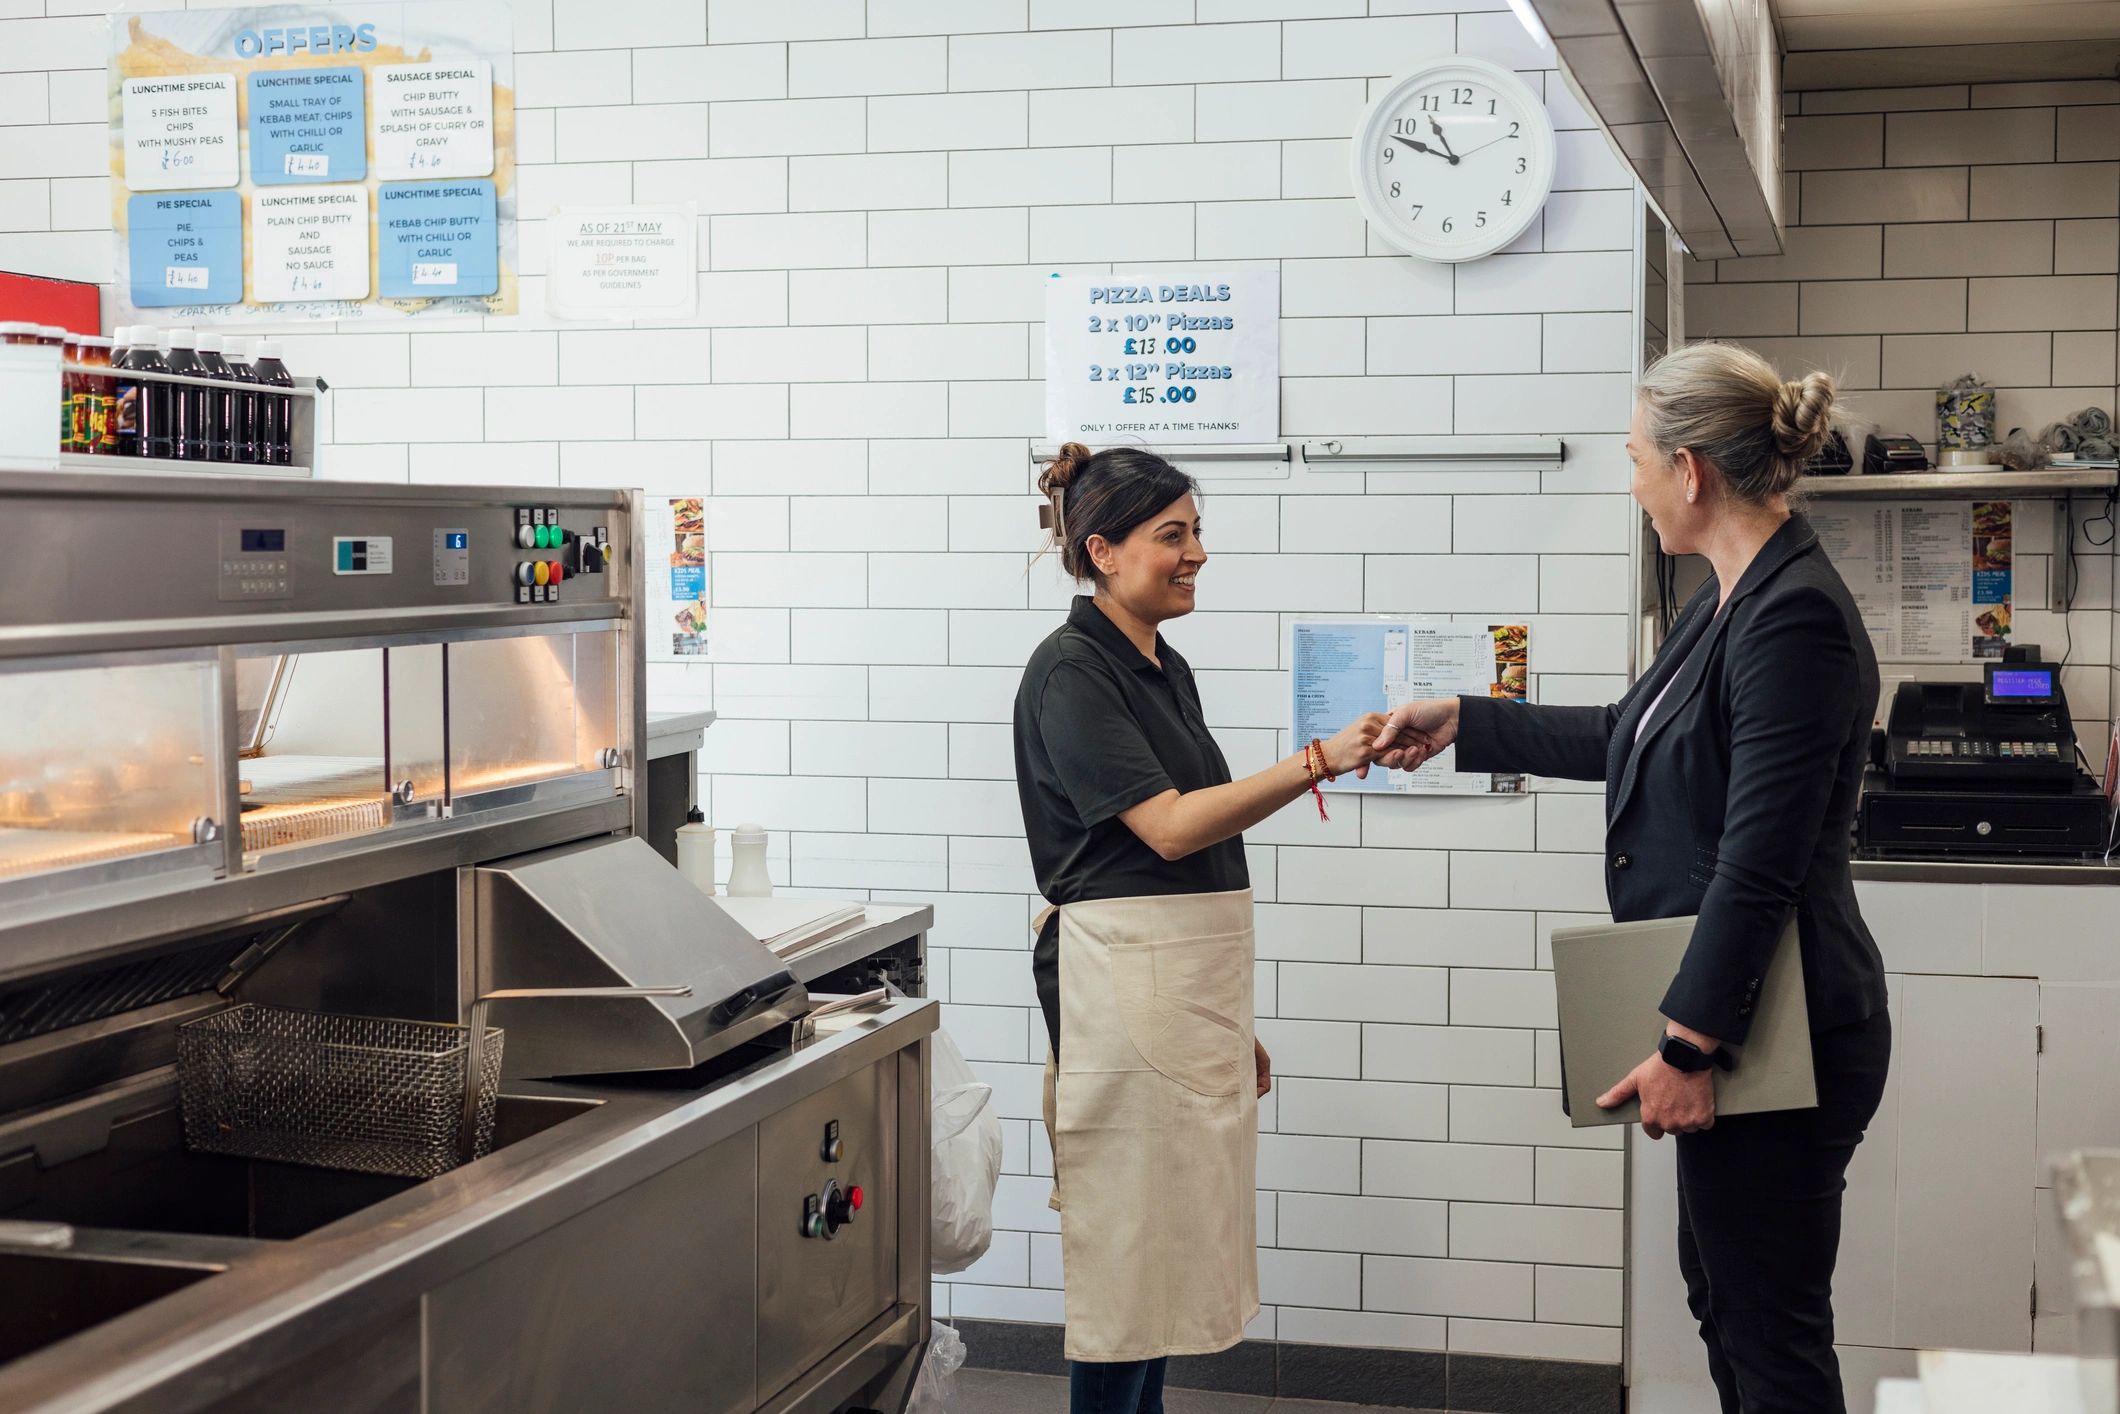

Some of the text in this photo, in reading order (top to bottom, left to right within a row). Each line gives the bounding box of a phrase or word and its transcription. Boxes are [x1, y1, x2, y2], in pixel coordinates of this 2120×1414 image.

[234, 23, 378, 60] OFFERS
[256, 75, 353, 88] LUNCHTIME SPECIAL
[386, 71, 475, 83] SAUSAGE SPECIAL
[131, 81, 226, 94] LUNCHTIME SPECIAL
[403, 91, 459, 102] CHIP BUTTY
[1450, 87, 1474, 105] 12
[269, 97, 342, 109] SMALL TRAY OF
[1419, 94, 1441, 112] 11
[1487, 98, 1497, 116] 1
[151, 107, 208, 118] 5 FISH BITES
[259, 114, 292, 124] KEBAB
[325, 111, 353, 121] CHIPS
[391, 106, 473, 118] WITH SAUSAGE &
[166, 122, 194, 132] CHIPS
[379, 120, 485, 134] SPLASH OF CURRY OR
[1393, 117, 1418, 136] 10
[1508, 121, 1520, 139] 2
[270, 127, 343, 139] WITH CHILLI OR
[137, 136, 224, 148] WITH MUSHY PEAS
[289, 143, 324, 153] GARLIC
[416, 137, 448, 147] GRAVY
[1383, 147, 1395, 165] 9
[1514, 156, 1527, 175] 3
[384, 187, 483, 201] LUNCHTIME SPECIAL
[1389, 181, 1402, 199] 8
[261, 195, 358, 207] LUNCHTIME SPECIAL
[1500, 189, 1512, 206] 4
[157, 199, 212, 210] PIE SPECIAL
[1411, 203, 1424, 222] 7
[267, 215, 352, 226] PLAIN CHIP BUTTY
[388, 216, 480, 229] KEBAB CHIP BUTTY
[1441, 216, 1454, 234] 6
[1474, 210, 1487, 228] 5
[580, 222, 594, 234] AS
[596, 222, 610, 234] OF
[637, 221, 662, 233] MAY
[299, 231, 321, 241] AND
[397, 232, 472, 244] WITH CHILLI OR
[167, 237, 204, 248] CHIPS &
[567, 238, 676, 248] WE ARE REQUIRED TO CHARGE
[288, 245, 333, 256] SAUSAGE
[417, 248, 453, 258] GARLIC
[174, 253, 199, 262] PEAS
[595, 253, 647, 265] 10P PER BAG
[286, 260, 335, 271] NO SAUCE
[582, 268, 660, 278] AS PER GOVERNMENT
[599, 281, 642, 290] GUIDELINES
[1089, 284, 1231, 304] PIZZA DEALS
[1088, 315, 1102, 333] 2
[1106, 319, 1119, 332] x
[1166, 311, 1234, 331] Pizzas
[1088, 364, 1103, 382] 2
[1107, 368, 1120, 381] x
[1165, 361, 1233, 380] Pizzas
[1080, 421, 1240, 433] ONLY 1 OFFER AT A TIME THANKS!
[455, 534, 462, 548] 6
